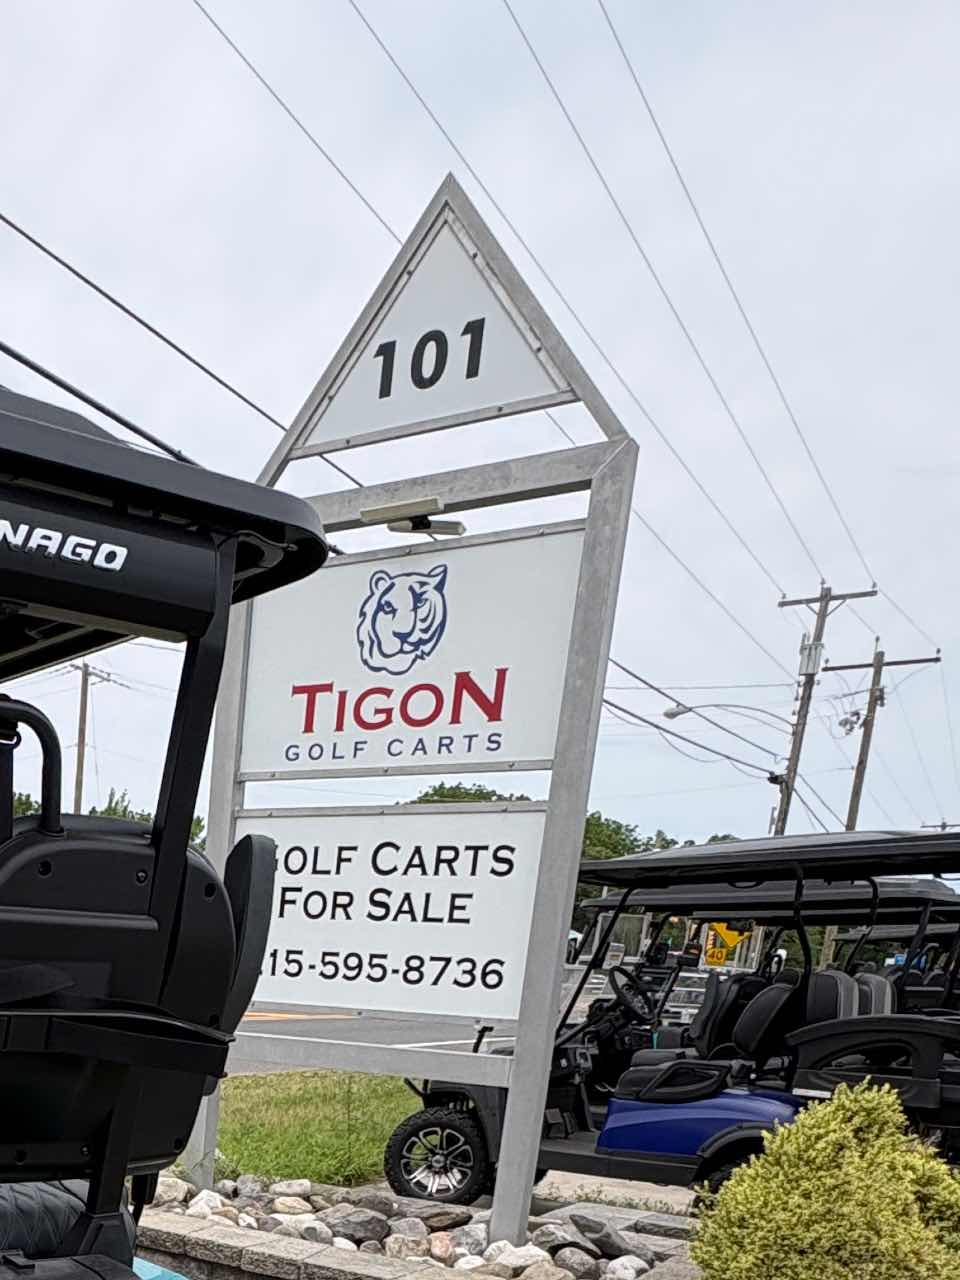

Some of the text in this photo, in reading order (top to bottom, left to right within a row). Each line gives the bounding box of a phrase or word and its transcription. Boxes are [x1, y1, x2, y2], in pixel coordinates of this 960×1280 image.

[373, 317, 486, 400] 101
[291, 667, 510, 735] TIGON
[284, 732, 504, 762] GOLF CARTS
[274, 841, 517, 877] OLF CARTS
[277, 886, 474, 924] FOR SALE
[259, 948, 506, 990] 15-595-8736
